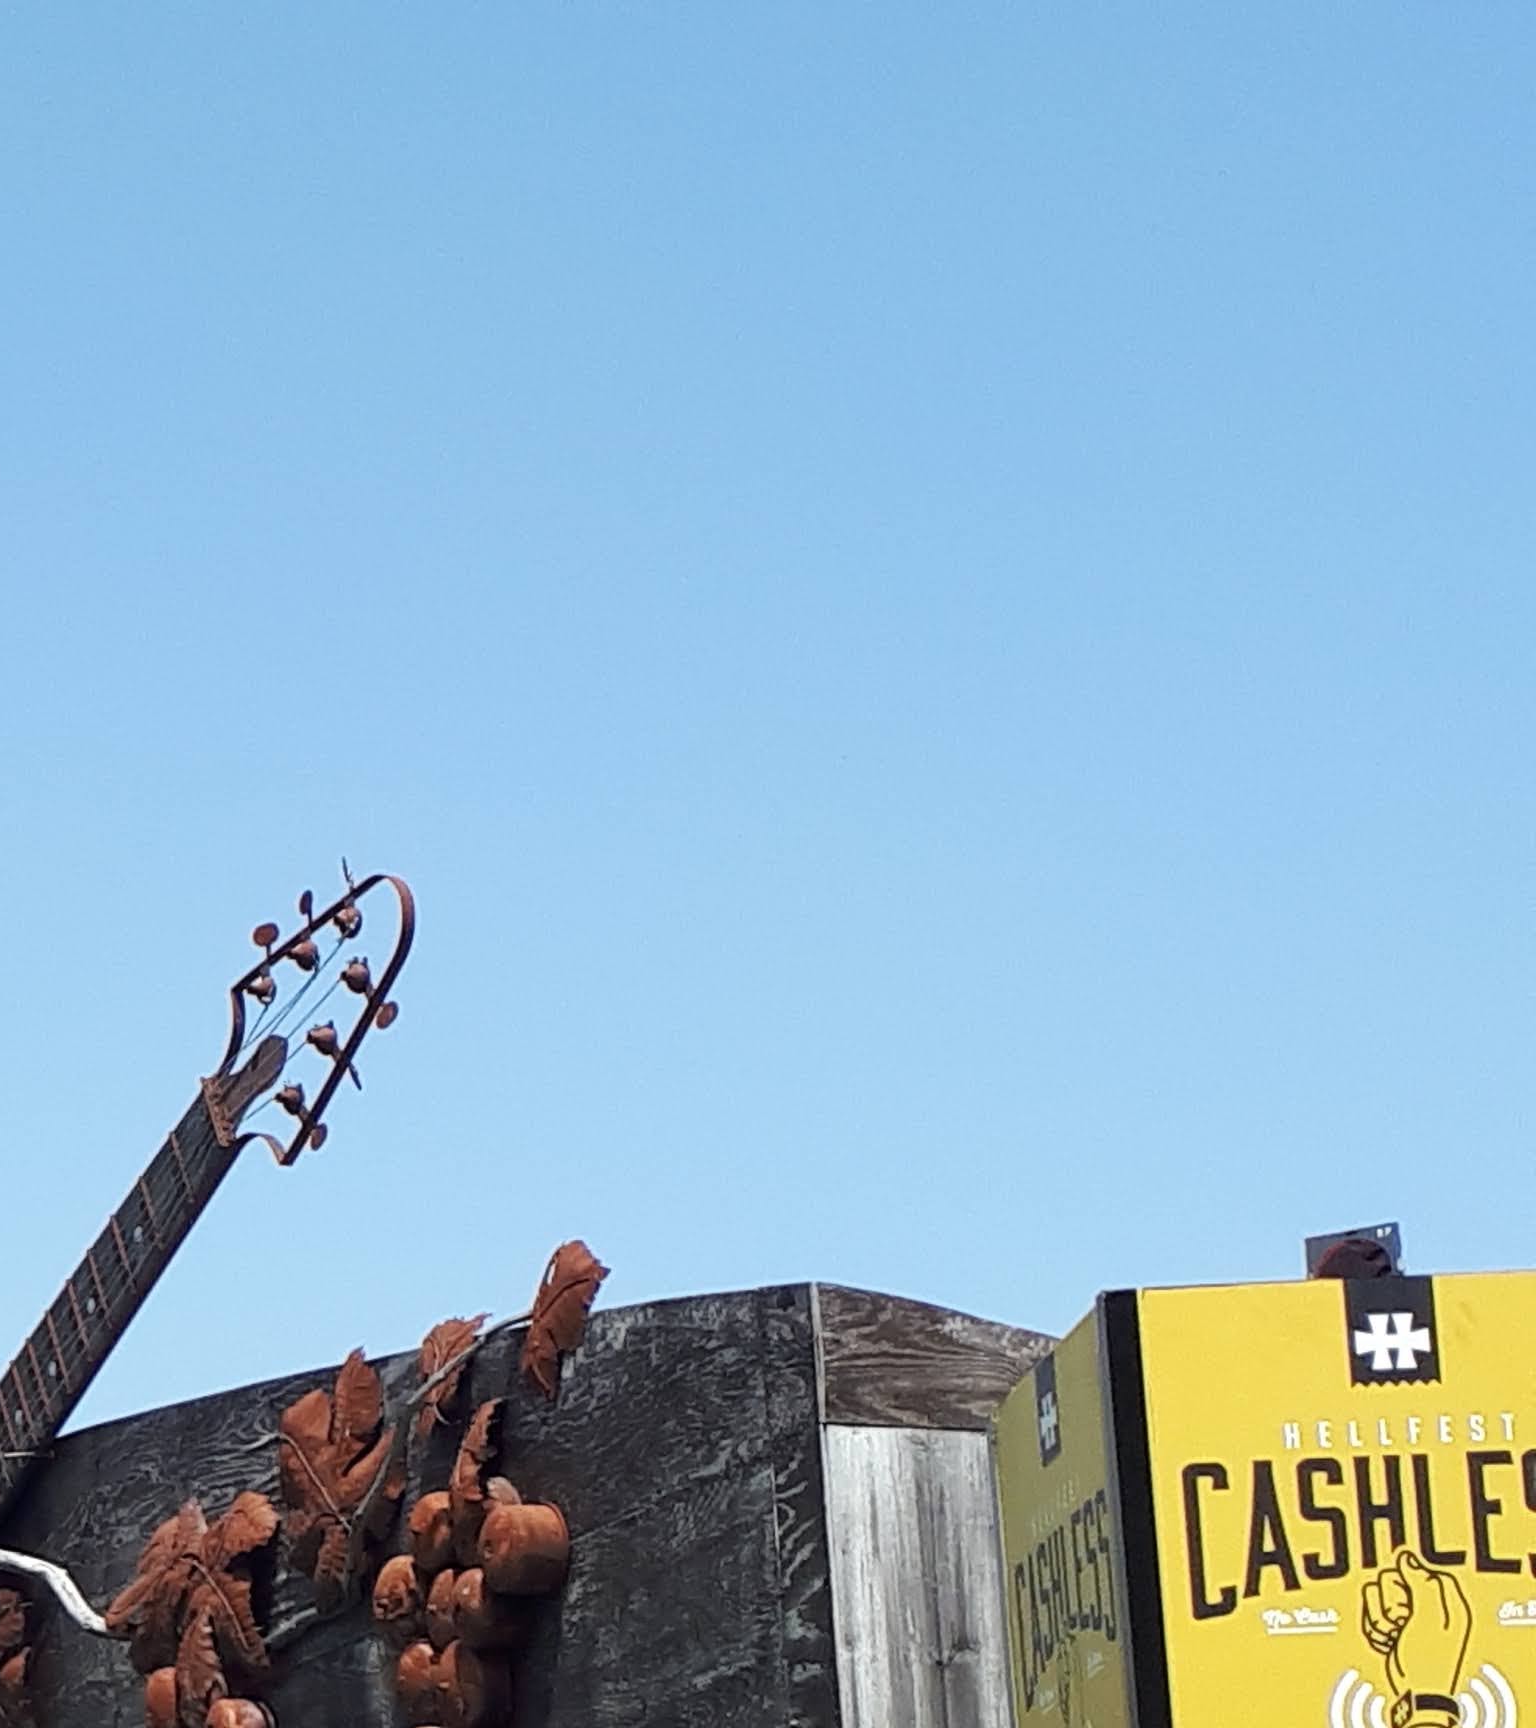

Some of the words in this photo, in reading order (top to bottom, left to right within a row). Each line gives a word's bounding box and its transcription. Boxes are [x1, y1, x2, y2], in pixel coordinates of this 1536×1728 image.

[1282, 1411, 1516, 1450] HELLFEST
[1014, 1488, 1117, 1713] CASHLESS
[1181, 1448, 1536, 1621] CASHLE
